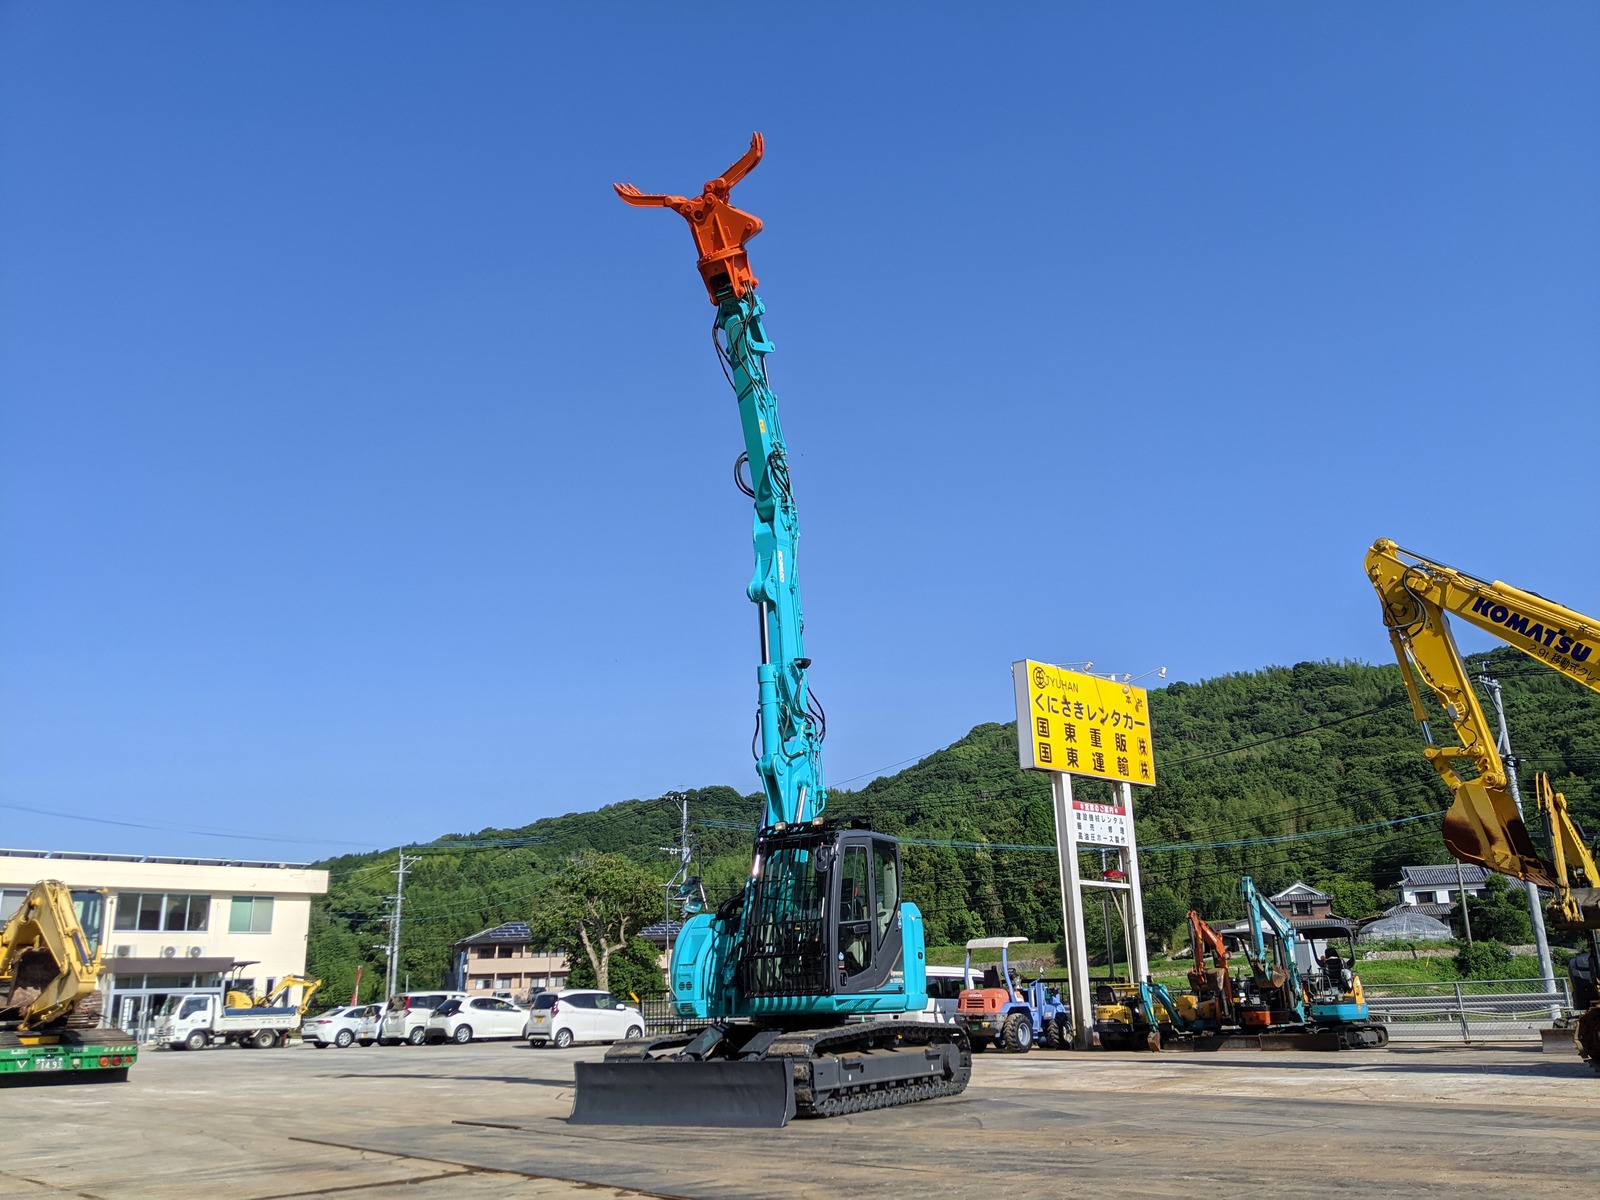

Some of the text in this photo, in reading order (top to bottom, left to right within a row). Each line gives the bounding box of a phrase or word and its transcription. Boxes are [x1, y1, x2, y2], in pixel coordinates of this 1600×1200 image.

[1471, 596, 1593, 662] KOMATSU
[1046, 675, 1079, 693] JYUHAN
[1035, 693, 1145, 730] くにさきレンタカー
